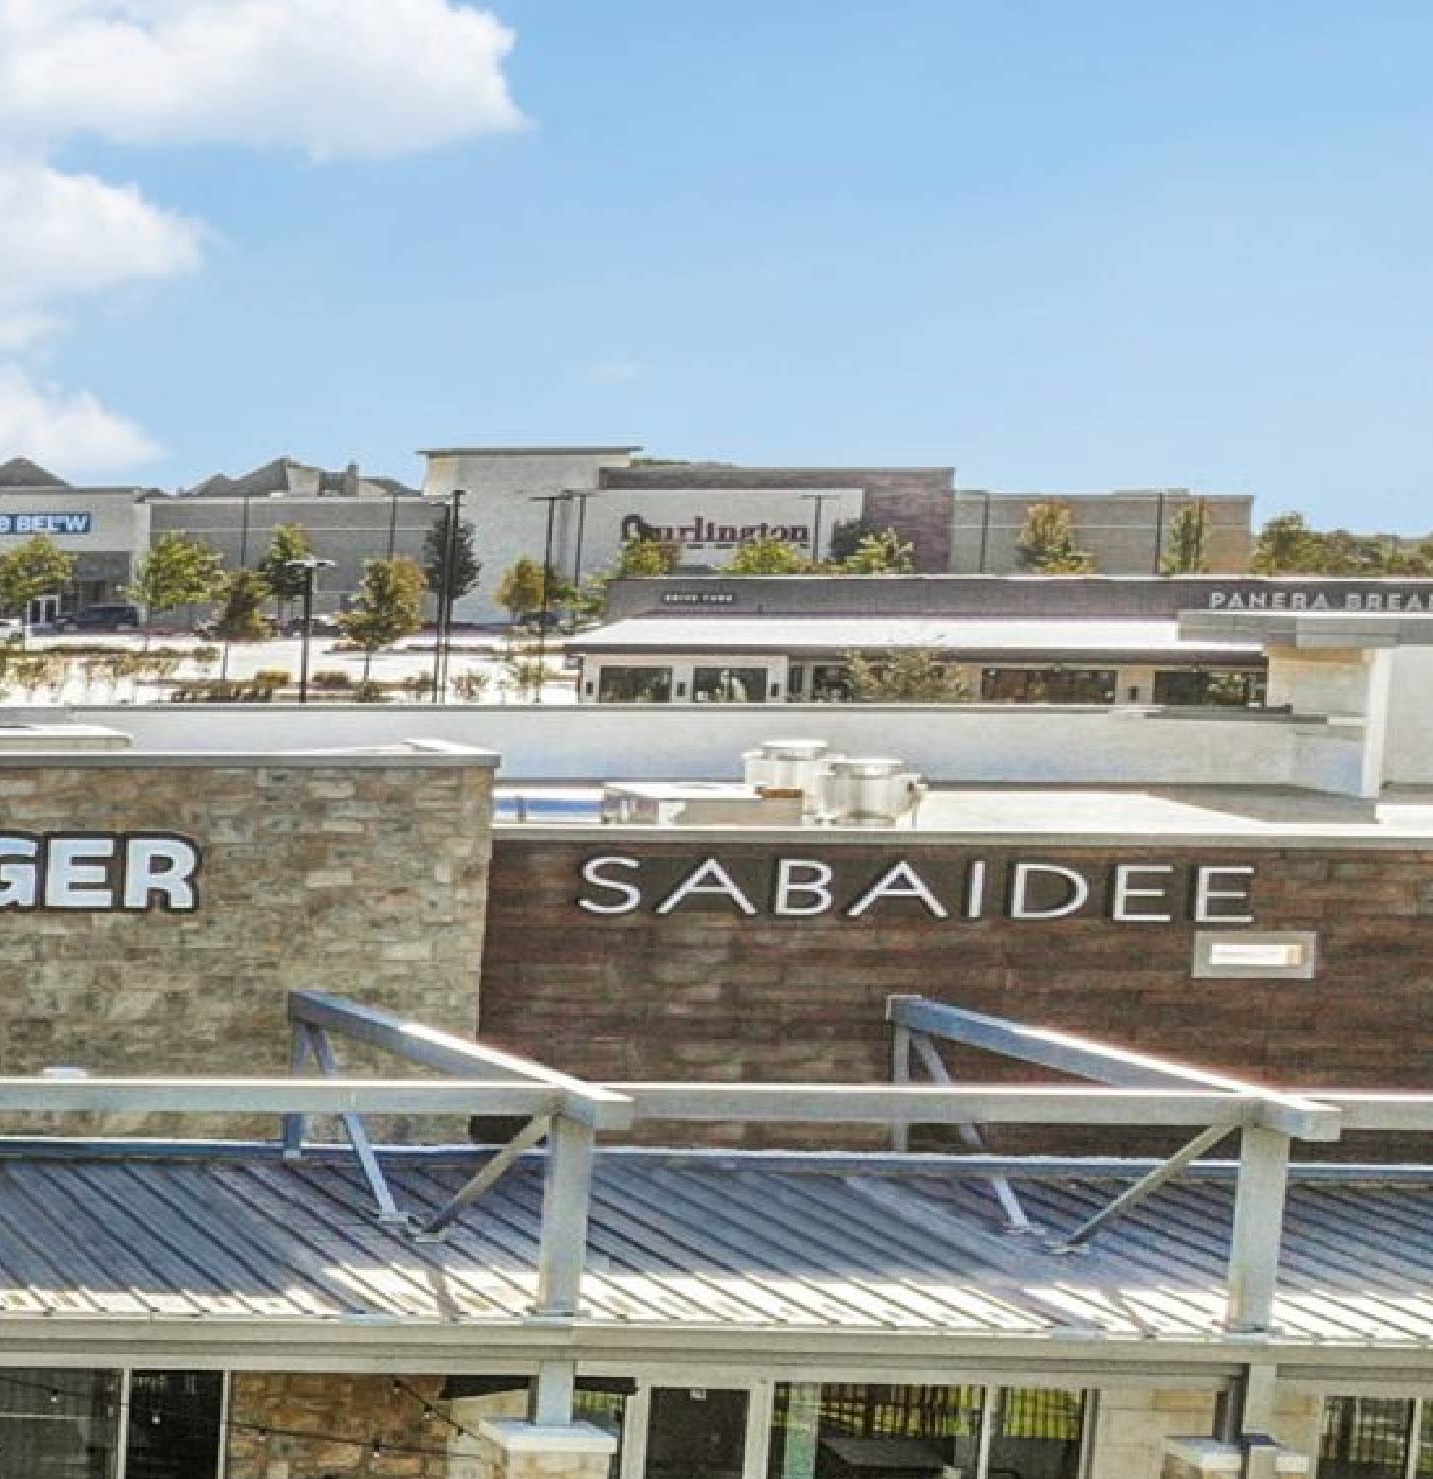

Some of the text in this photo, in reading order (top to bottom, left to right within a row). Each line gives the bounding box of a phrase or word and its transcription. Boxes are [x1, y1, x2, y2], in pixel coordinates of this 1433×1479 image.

[1210, 592, 1433, 609] PANERA BREA
[579, 856, 1256, 924] SABAIDEE
